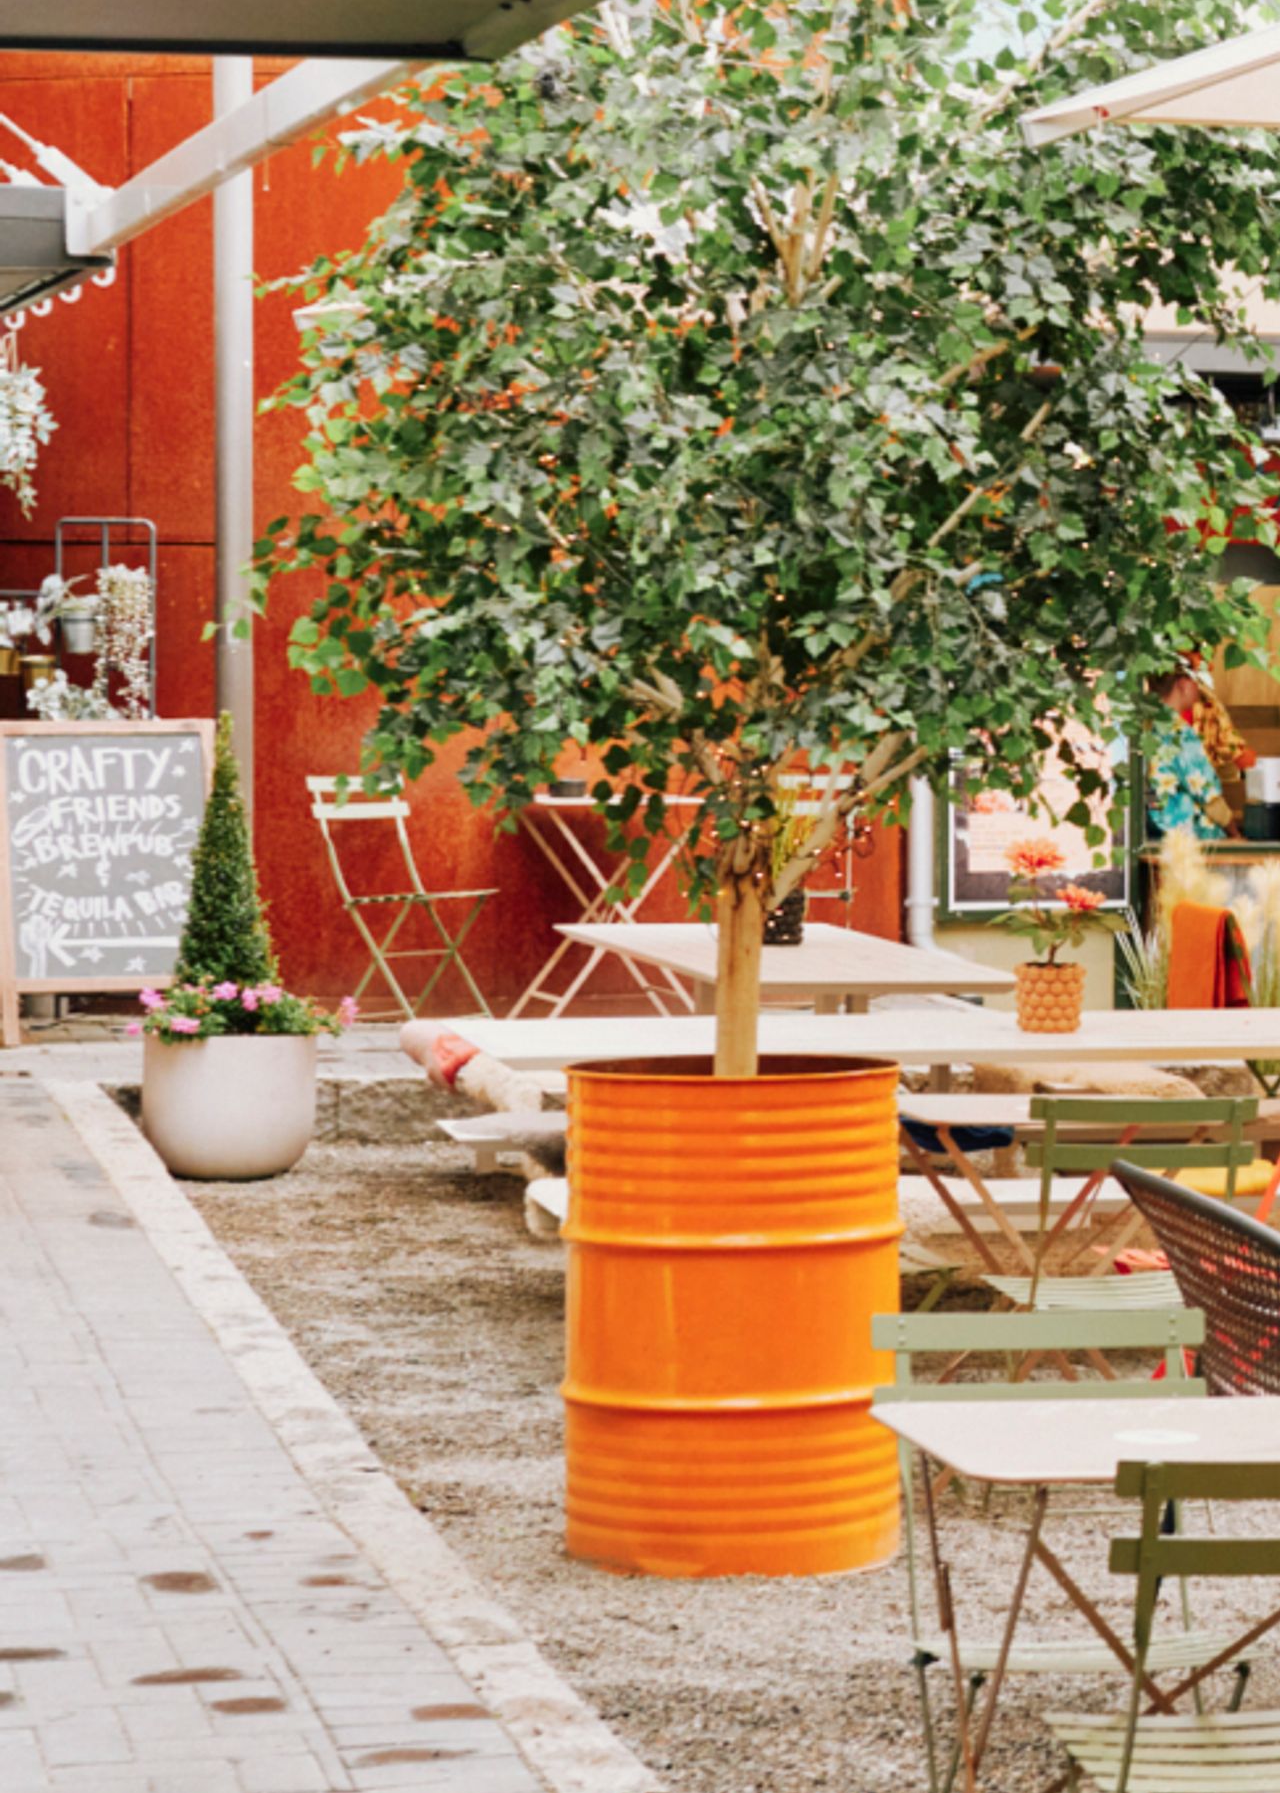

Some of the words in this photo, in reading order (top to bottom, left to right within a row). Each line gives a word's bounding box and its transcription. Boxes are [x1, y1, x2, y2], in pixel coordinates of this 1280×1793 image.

[18, 745, 172, 795] CRAFTY
[48, 794, 183, 829] FRIENDS
[33, 831, 175, 864] BREWPUB
[27, 884, 134, 922] TEQUILA
[133, 881, 190, 916] BAR
